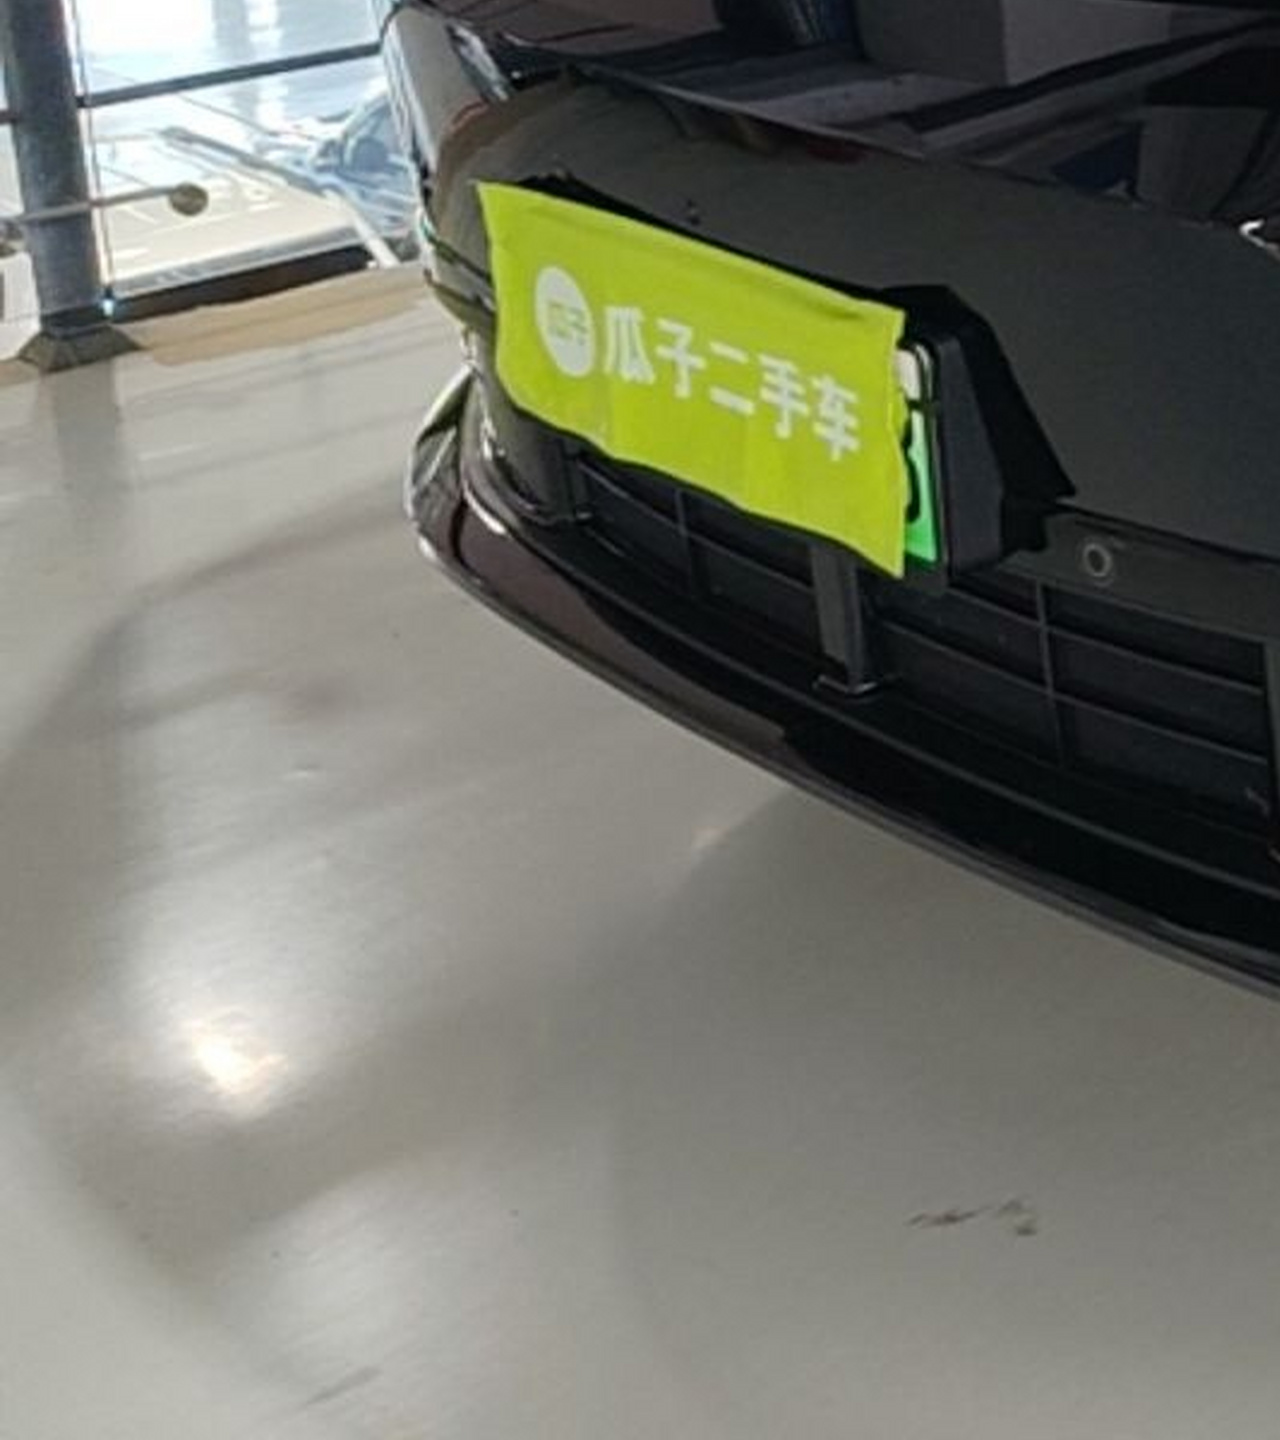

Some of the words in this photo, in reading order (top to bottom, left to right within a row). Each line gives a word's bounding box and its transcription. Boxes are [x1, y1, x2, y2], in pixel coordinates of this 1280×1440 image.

[603, 305, 859, 462] 瓜子二手车
